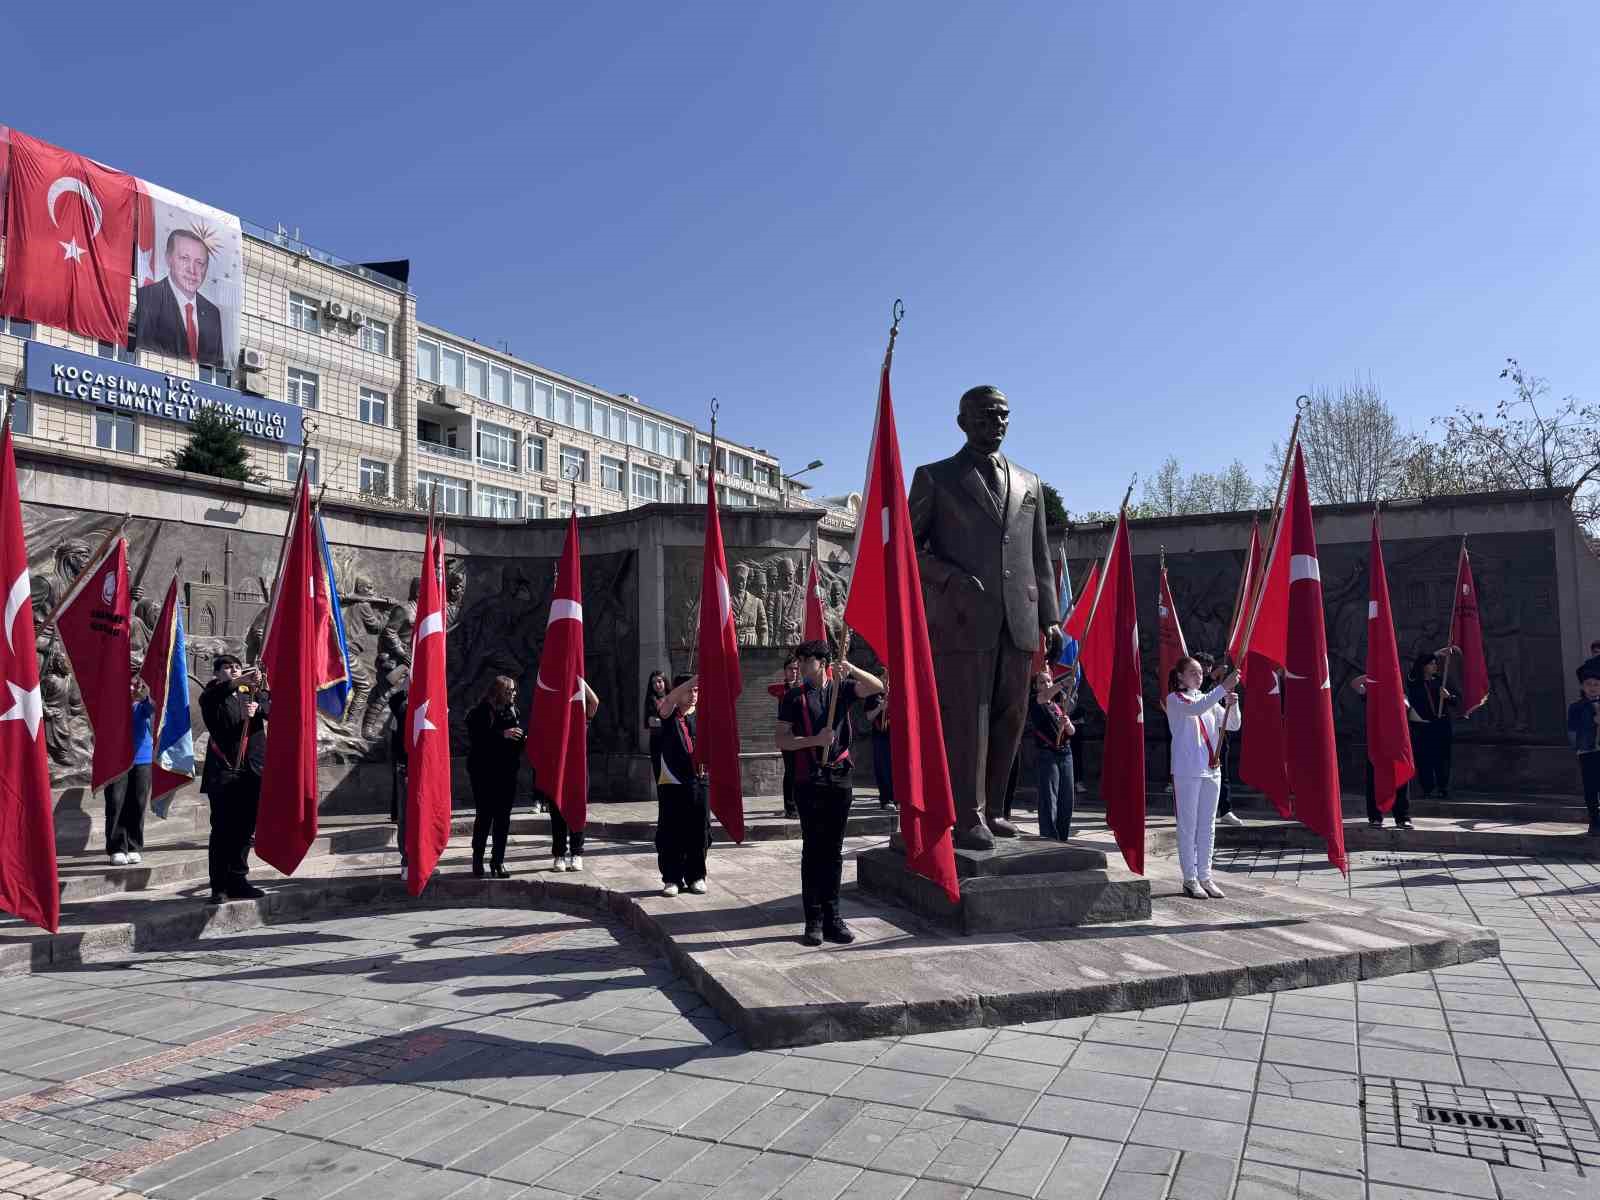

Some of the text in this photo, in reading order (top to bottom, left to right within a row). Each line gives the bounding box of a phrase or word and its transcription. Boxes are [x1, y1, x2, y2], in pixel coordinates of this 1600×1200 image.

[53, 363, 287, 426] KOCASİNAN KAYMAKAMLIĞI
[56, 376, 101, 400] İLÇE
[107, 389, 185, 417] EMNİYET
[166, 376, 194, 392] T.C.
